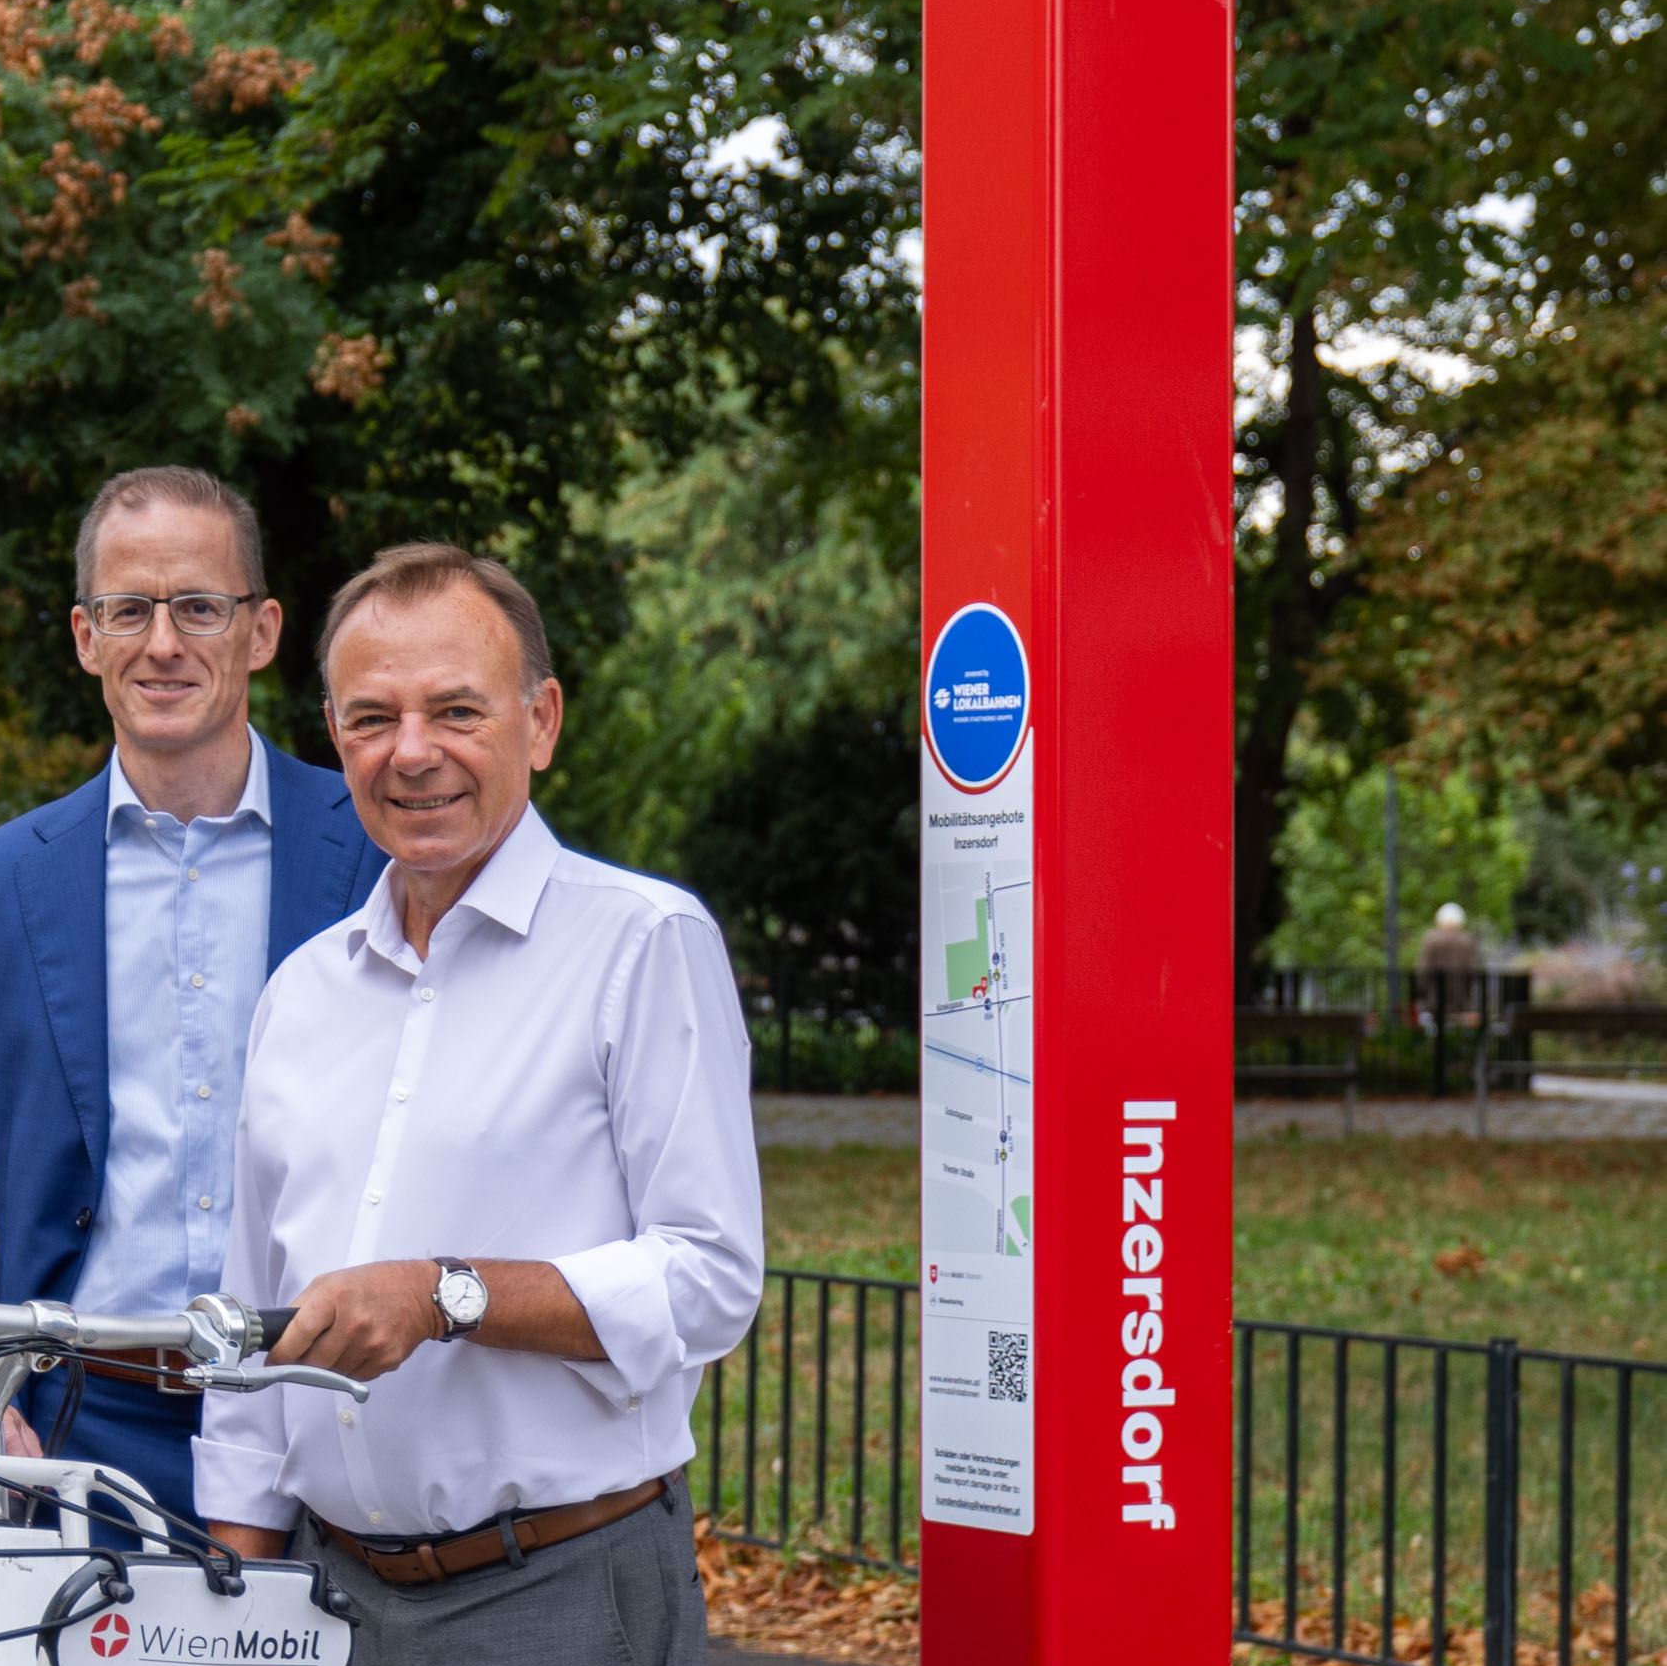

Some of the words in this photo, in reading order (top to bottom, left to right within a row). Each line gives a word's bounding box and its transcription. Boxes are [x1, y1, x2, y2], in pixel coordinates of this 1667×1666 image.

[953, 682, 990, 696] WIENER
[953, 695, 1022, 711] LOKALBAHNEN
[929, 810, 1025, 828] Mobilitätsangebote
[954, 835, 999, 850] Inzersdorf
[1121, 1100, 1177, 1530] Inzersdorf
[139, 1623, 321, 1661] WienMobil
